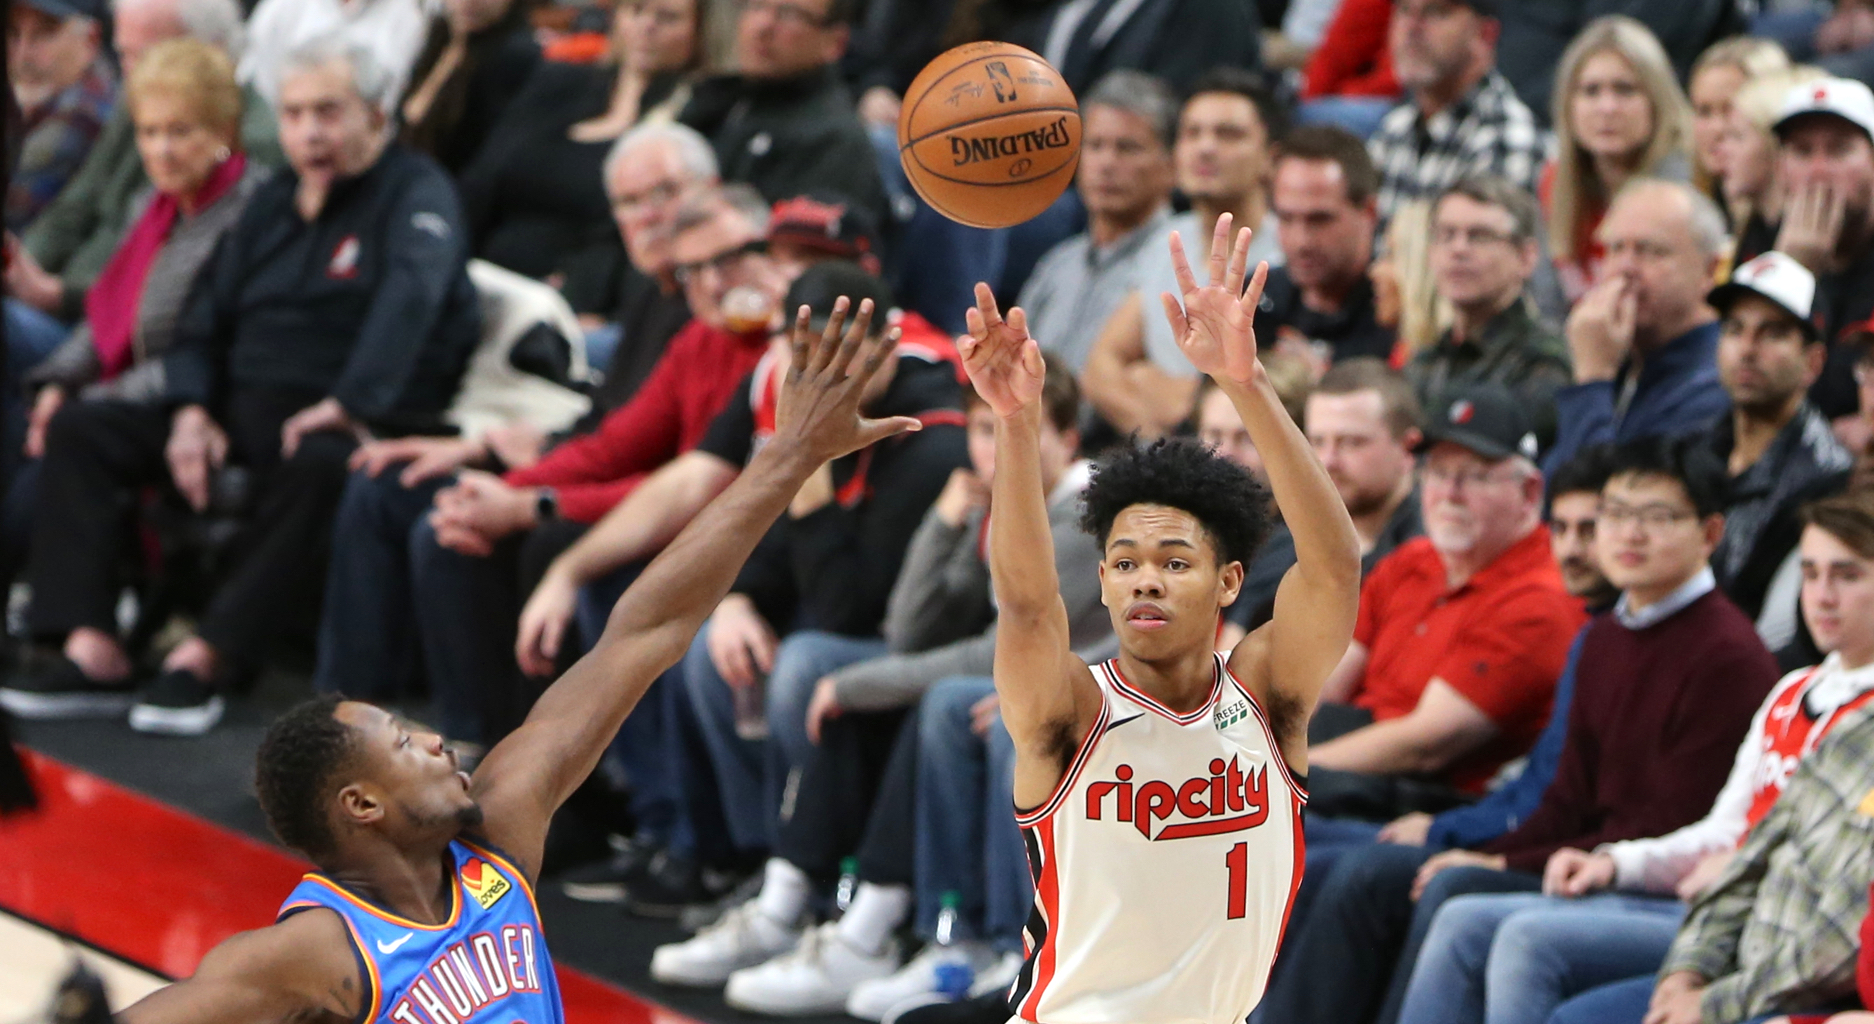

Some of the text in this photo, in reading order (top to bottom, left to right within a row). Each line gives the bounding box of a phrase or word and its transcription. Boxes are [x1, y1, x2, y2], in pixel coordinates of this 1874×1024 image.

[951, 116, 1070, 166] SPALDING
[1086, 752, 1269, 841] ripcity
[1226, 841, 1248, 920] 1
